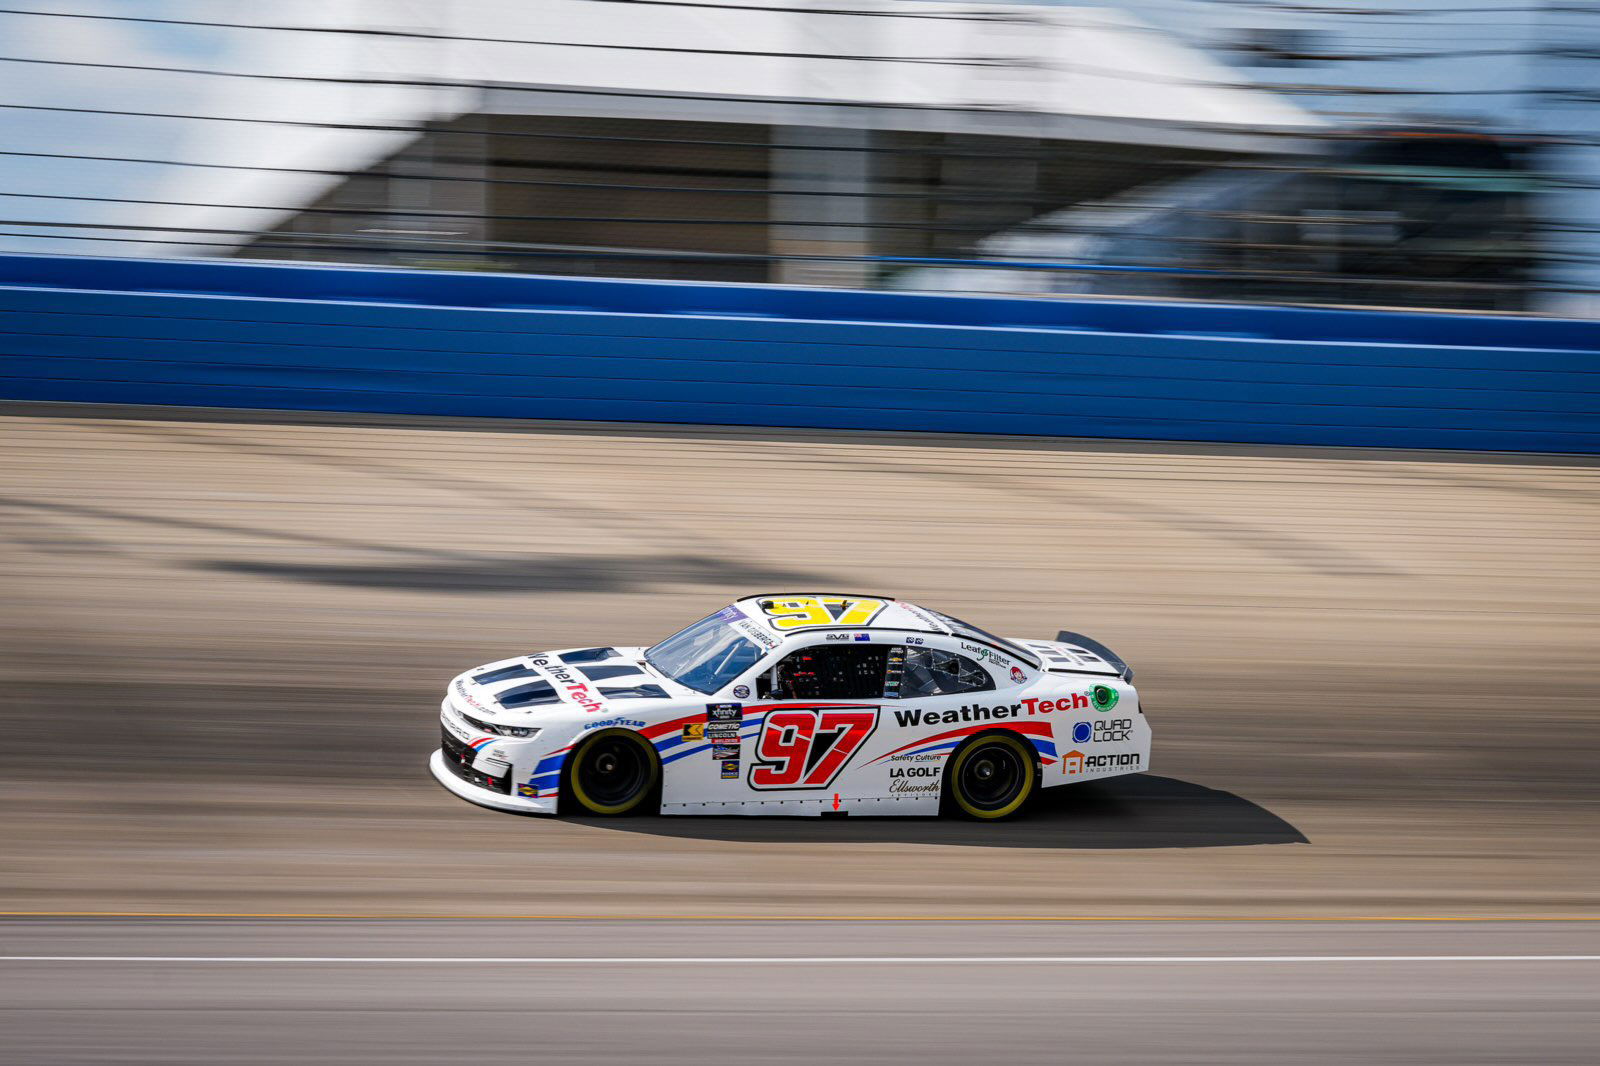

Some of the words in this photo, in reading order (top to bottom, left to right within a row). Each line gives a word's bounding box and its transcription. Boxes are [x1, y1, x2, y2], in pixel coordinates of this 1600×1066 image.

[894, 693, 1090, 728] WeatherTech
[584, 717, 646, 730] GOODYEAR
[1094, 719, 1132, 731] QUAD
[1093, 730, 1131, 742] LOCK
[748, 706, 881, 791] 97
[1085, 753, 1140, 767] ACTION
[890, 768, 905, 778] LA
[907, 767, 941, 778] GOLF
[889, 779, 940, 793] Ellsworth
